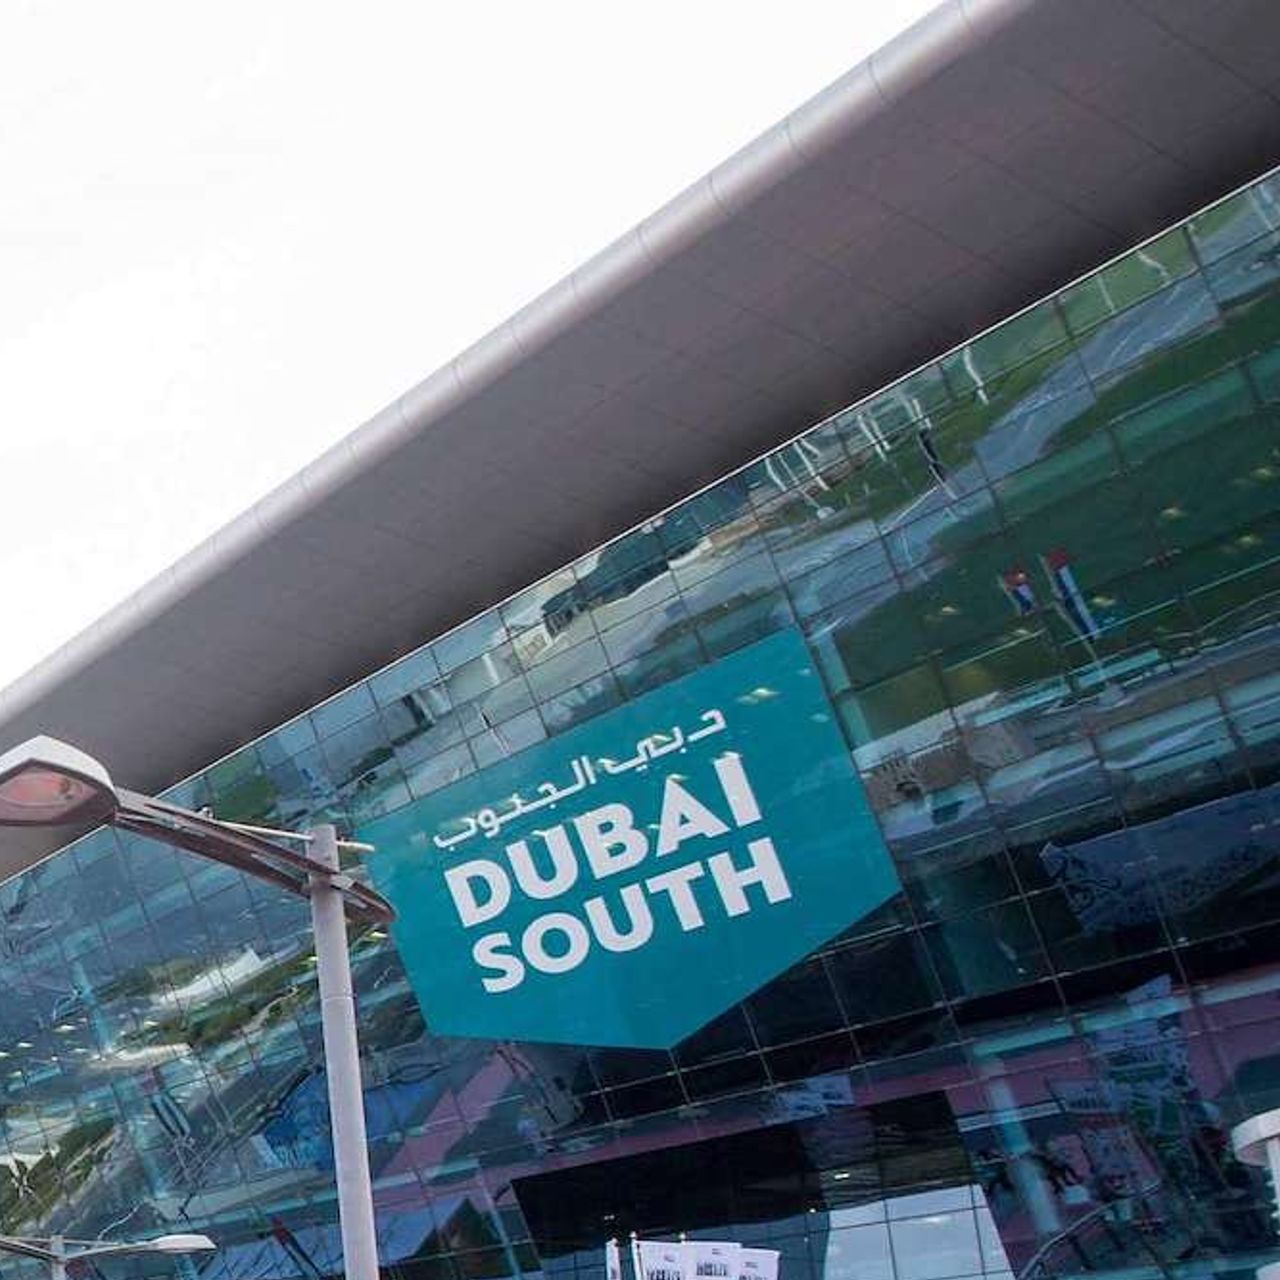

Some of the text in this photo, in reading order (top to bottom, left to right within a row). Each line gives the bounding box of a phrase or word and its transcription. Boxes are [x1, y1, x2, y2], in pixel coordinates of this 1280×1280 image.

[433, 709, 727, 851] دبي الجنوب
[444, 754, 762, 928] DUBAI
[472, 837, 792, 993] SOUTH
